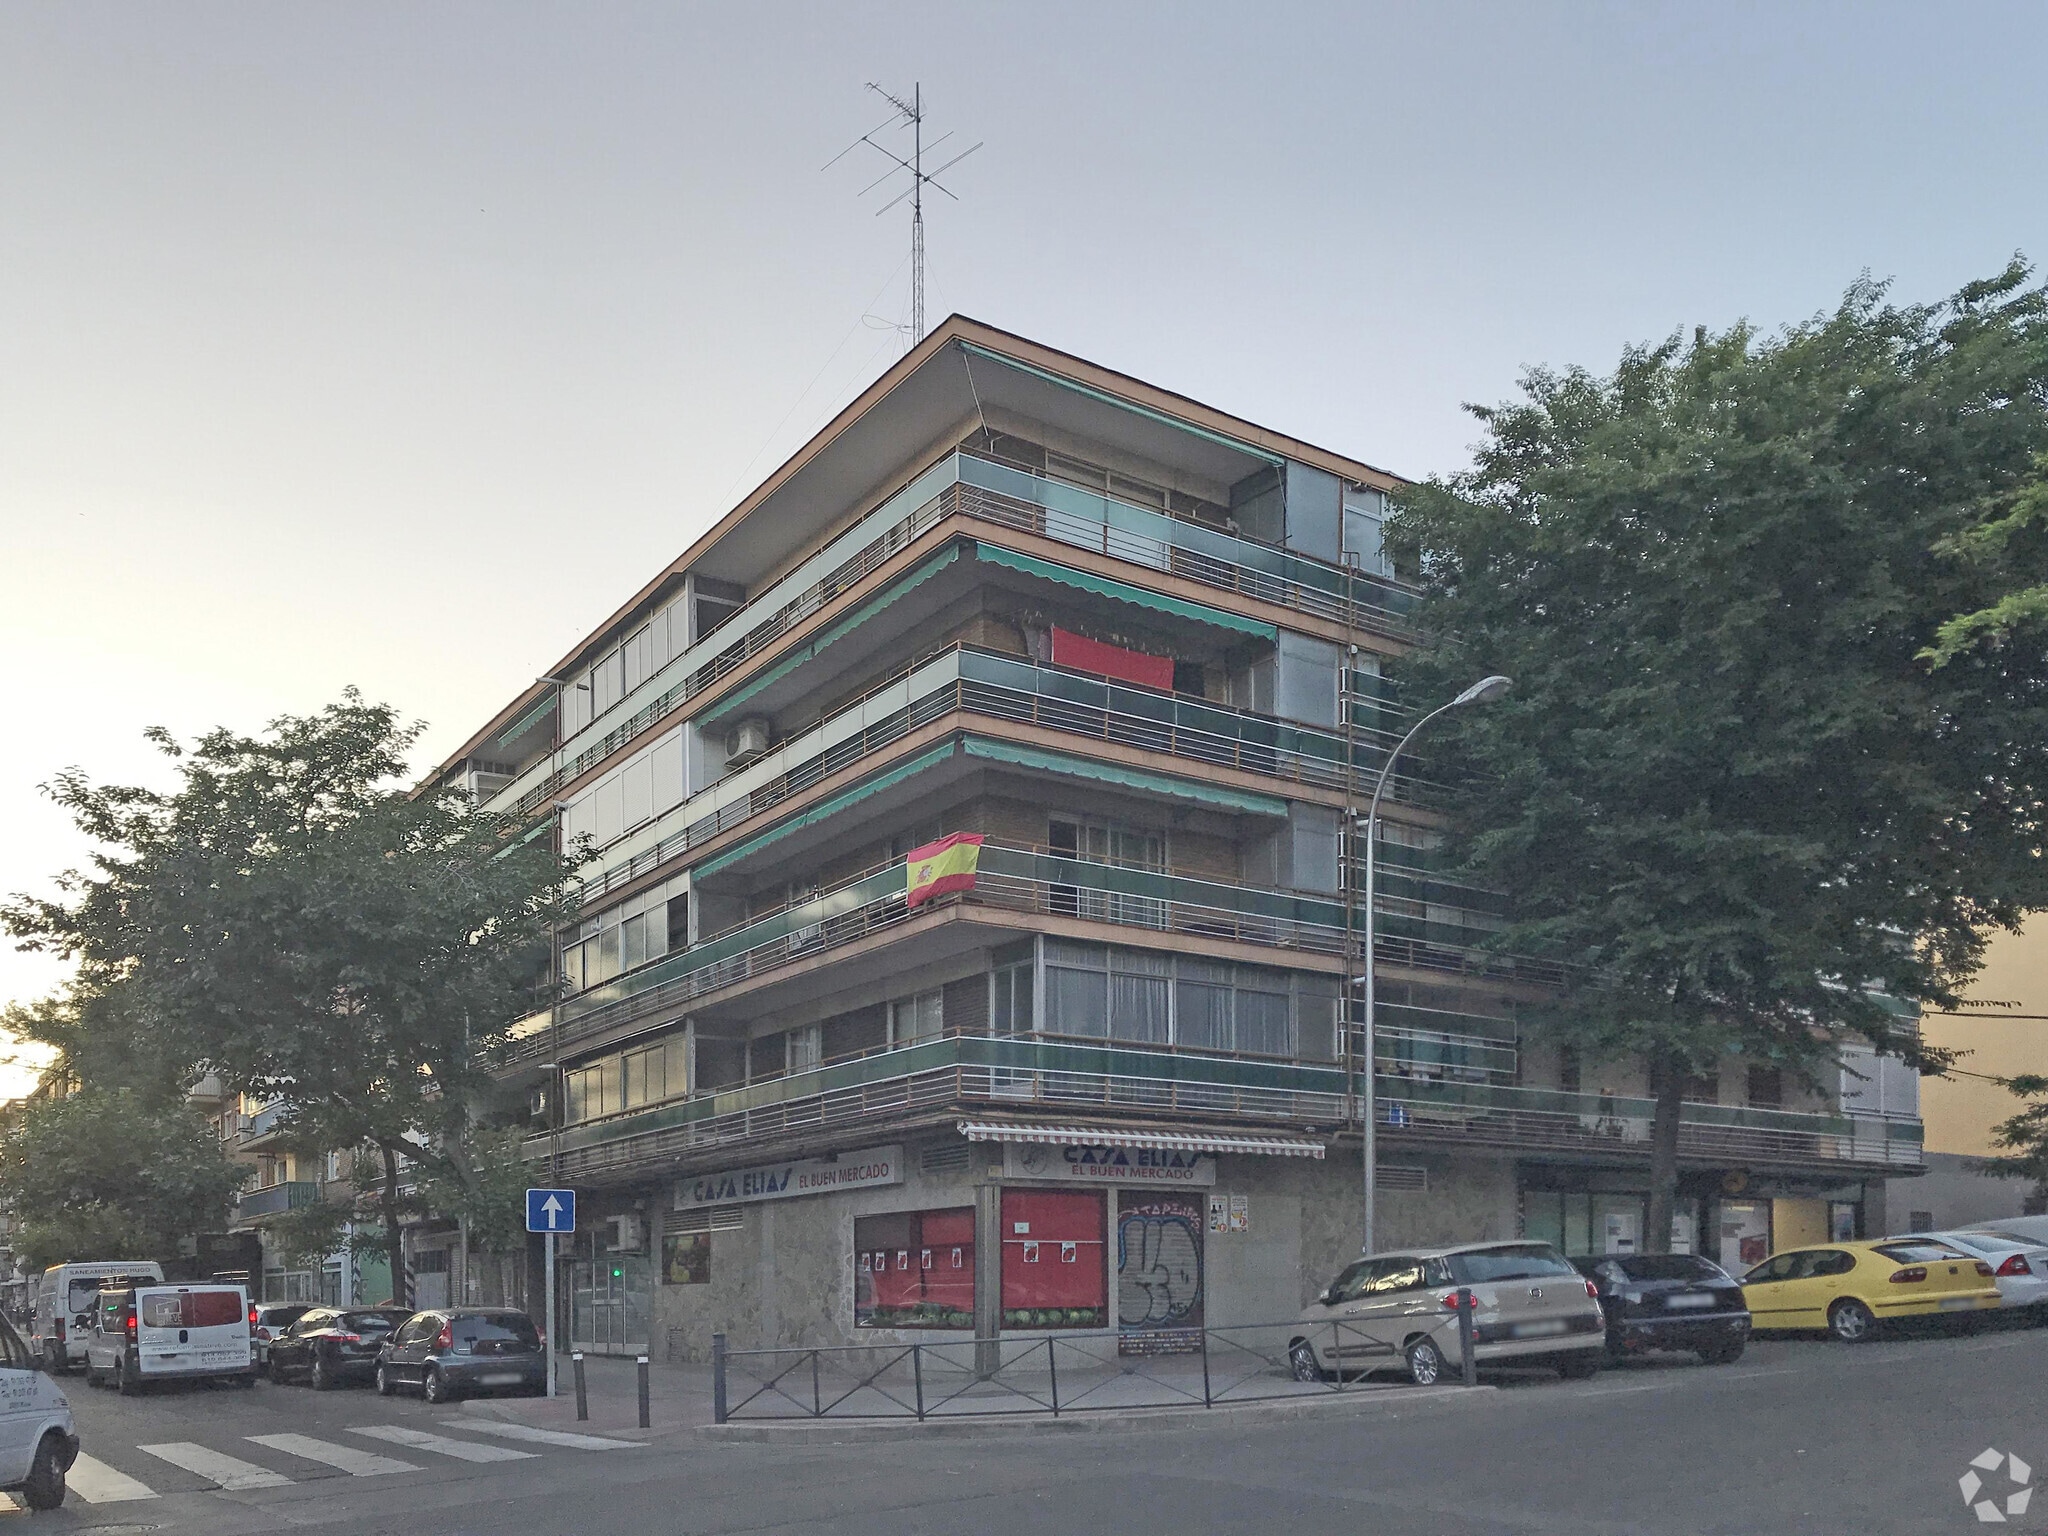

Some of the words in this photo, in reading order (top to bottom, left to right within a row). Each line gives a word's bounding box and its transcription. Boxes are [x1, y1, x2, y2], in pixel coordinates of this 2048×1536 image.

[1063, 1145, 1130, 1166] CASA
[1138, 1148, 1201, 1169] ELIAS
[693, 1177, 738, 1202] CASA
[743, 1167, 794, 1197] ELIAS
[799, 1174, 811, 1189] EL
[811, 1170, 836, 1187] BUEN
[839, 1162, 890, 1185] MERCADO
[1072, 1165, 1085, 1176] EL
[1090, 1165, 1126, 1178] BUEN
[1129, 1167, 1194, 1180] MERCADO
